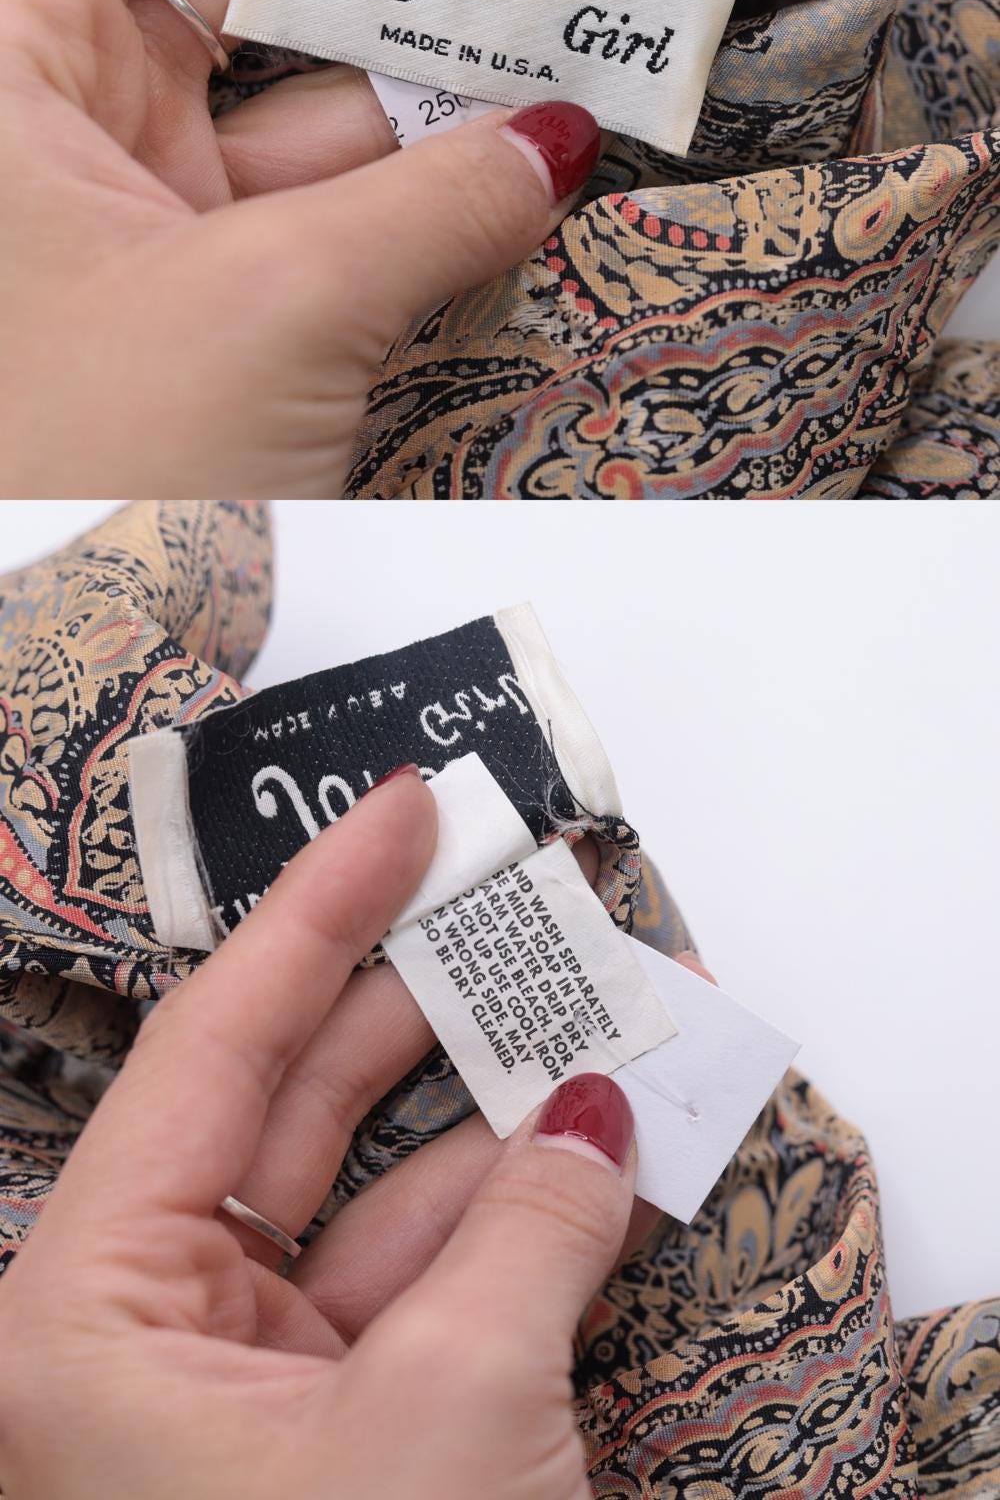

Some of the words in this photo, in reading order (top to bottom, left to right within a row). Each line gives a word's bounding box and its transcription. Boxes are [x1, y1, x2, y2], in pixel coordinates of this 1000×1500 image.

[380, 23, 452, 56] MADE
[459, 43, 482, 64] IN
[490, 52, 560, 83] U.S.A.
[563, 5, 675, 75] Girl
[433, 906, 449, 921] N
[444, 922, 487, 986] WRONG
[481, 988, 508, 1028] SIDE.
[504, 1029, 535, 1063] MAY
[471, 901, 499, 935] NOT
[493, 936, 517, 968] USE
[510, 968, 553, 1033] BLEACH.
[548, 1033, 574, 1067] FOR
[478, 877, 509, 921] ARM
[504, 920, 543, 979] WATER
[537, 979, 568, 1017] DRIP
[561, 1020, 589, 1053] DRY
[491, 869, 511, 889] SE
[505, 890, 535, 928] MILD
[530, 931, 562, 974] SOAP
[556, 976, 576, 998] IN
[507, 861, 534, 894] AND
[530, 894, 565, 946] WASH
[558, 947, 622, 1041] SEPARATELY
[435, 944, 455, 966] BE
[448, 966, 477, 1000] DRY
[471, 1004, 516, 1075] CLEANED.
[473, 937, 493, 960] UP
[488, 962, 512, 994] USE
[507, 996, 539, 1041] COOL
[532, 1040, 565, 1082] IRON
